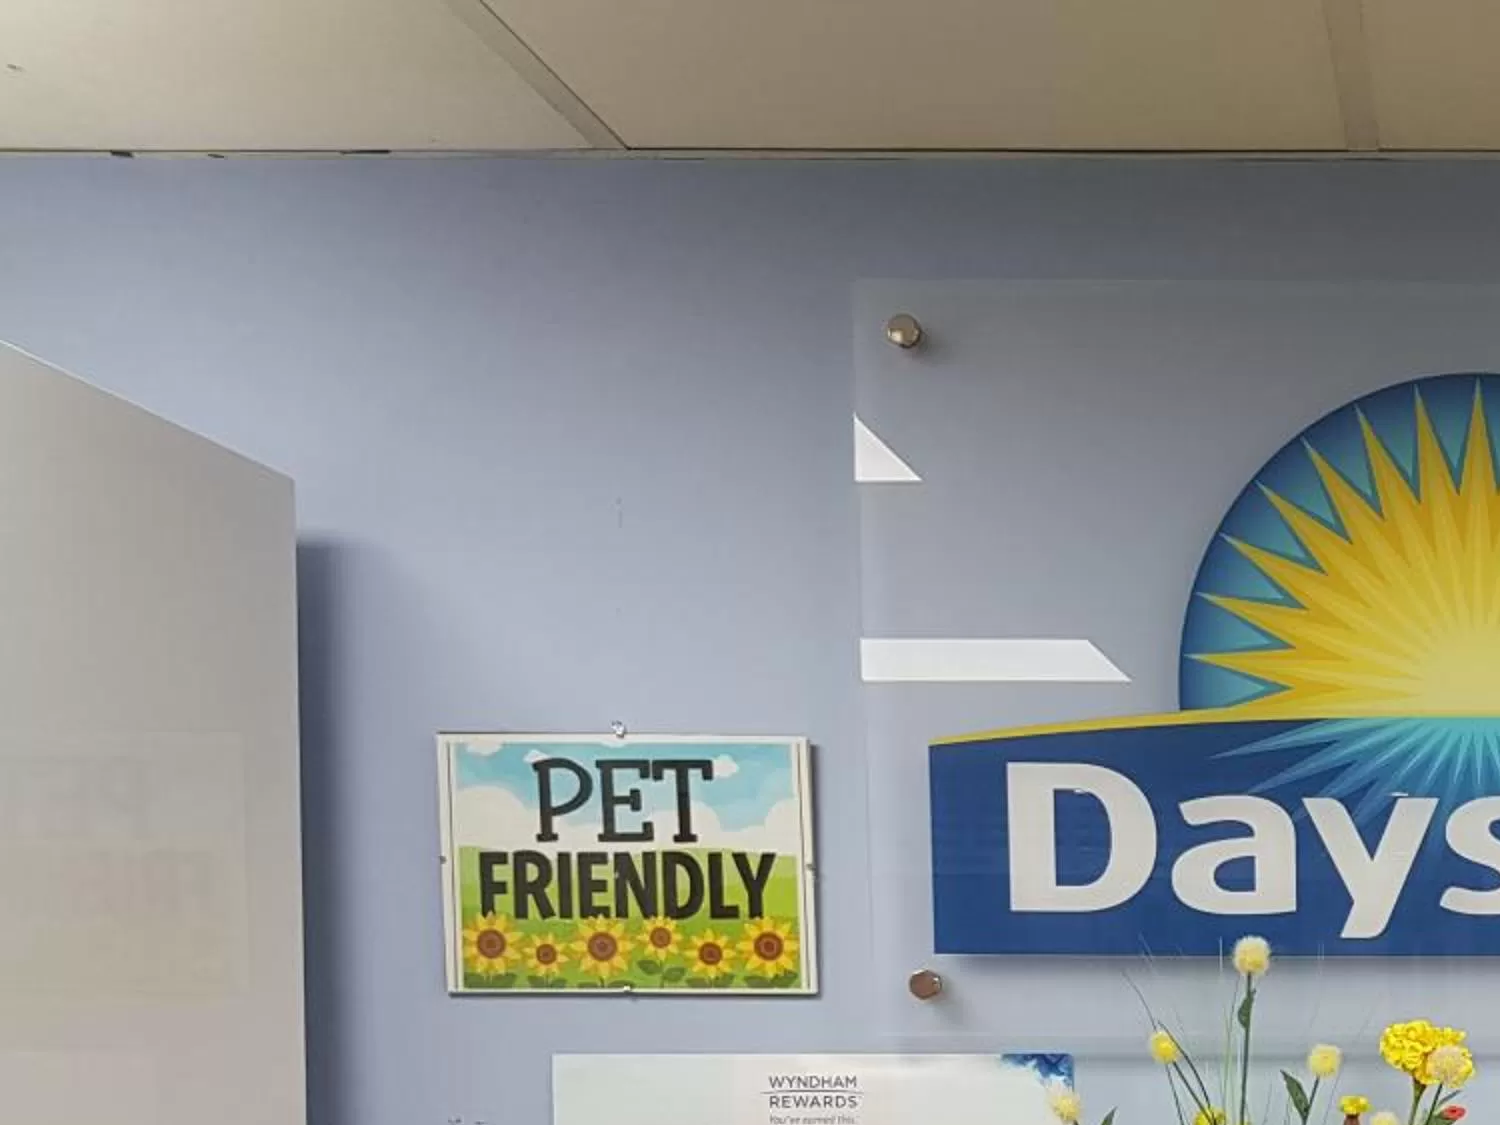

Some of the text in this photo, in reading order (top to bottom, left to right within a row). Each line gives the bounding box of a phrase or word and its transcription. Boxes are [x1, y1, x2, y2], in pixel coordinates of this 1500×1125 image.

[533, 757, 713, 842] PET
[479, 850, 777, 919] FRIENDLY
[768, 1075, 858, 1089] WYNDHAM
[769, 1095, 859, 1109] REWARDS
